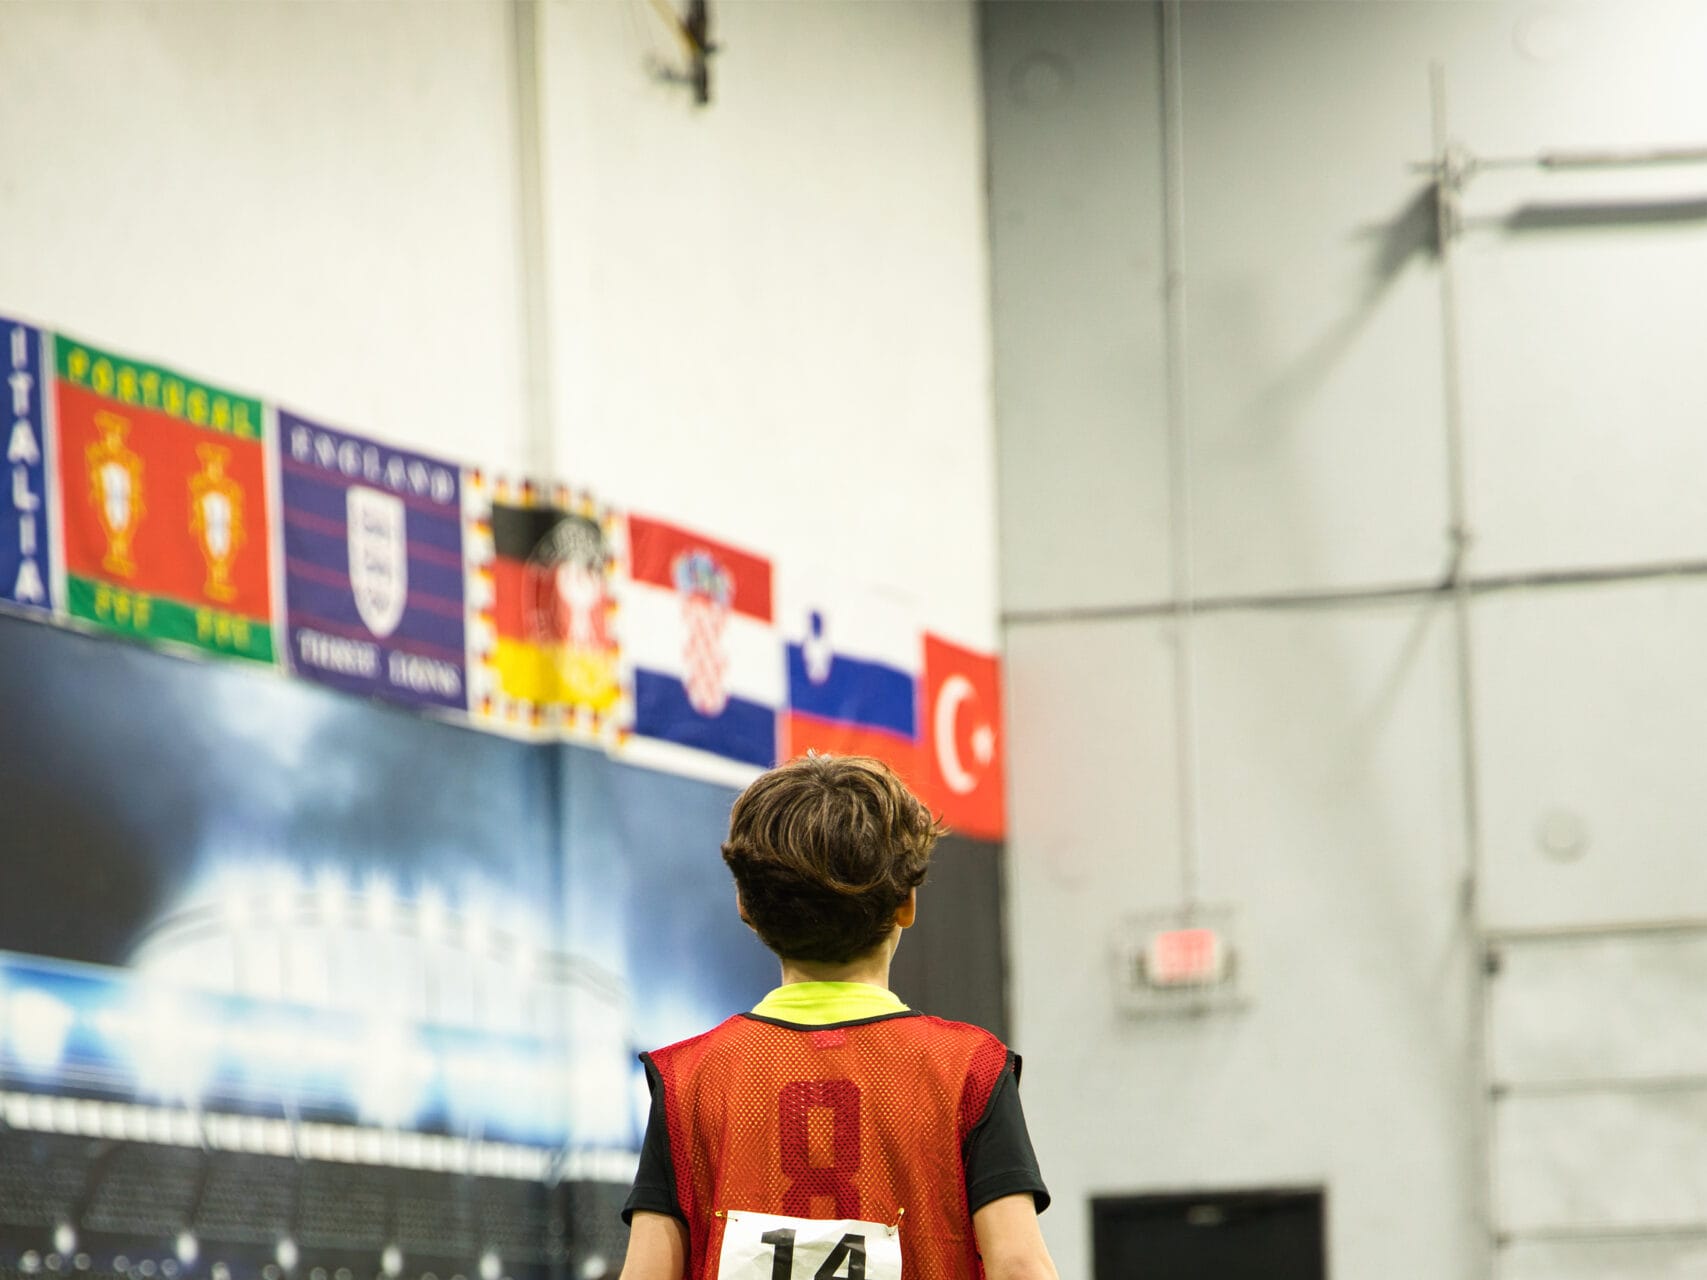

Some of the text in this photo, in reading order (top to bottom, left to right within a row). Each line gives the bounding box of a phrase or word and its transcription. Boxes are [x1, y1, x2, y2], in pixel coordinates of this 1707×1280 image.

[68, 348, 253, 439] PORTUGAL
[9, 327, 41, 603] ITALIA
[290, 424, 455, 504] ENGLAND
